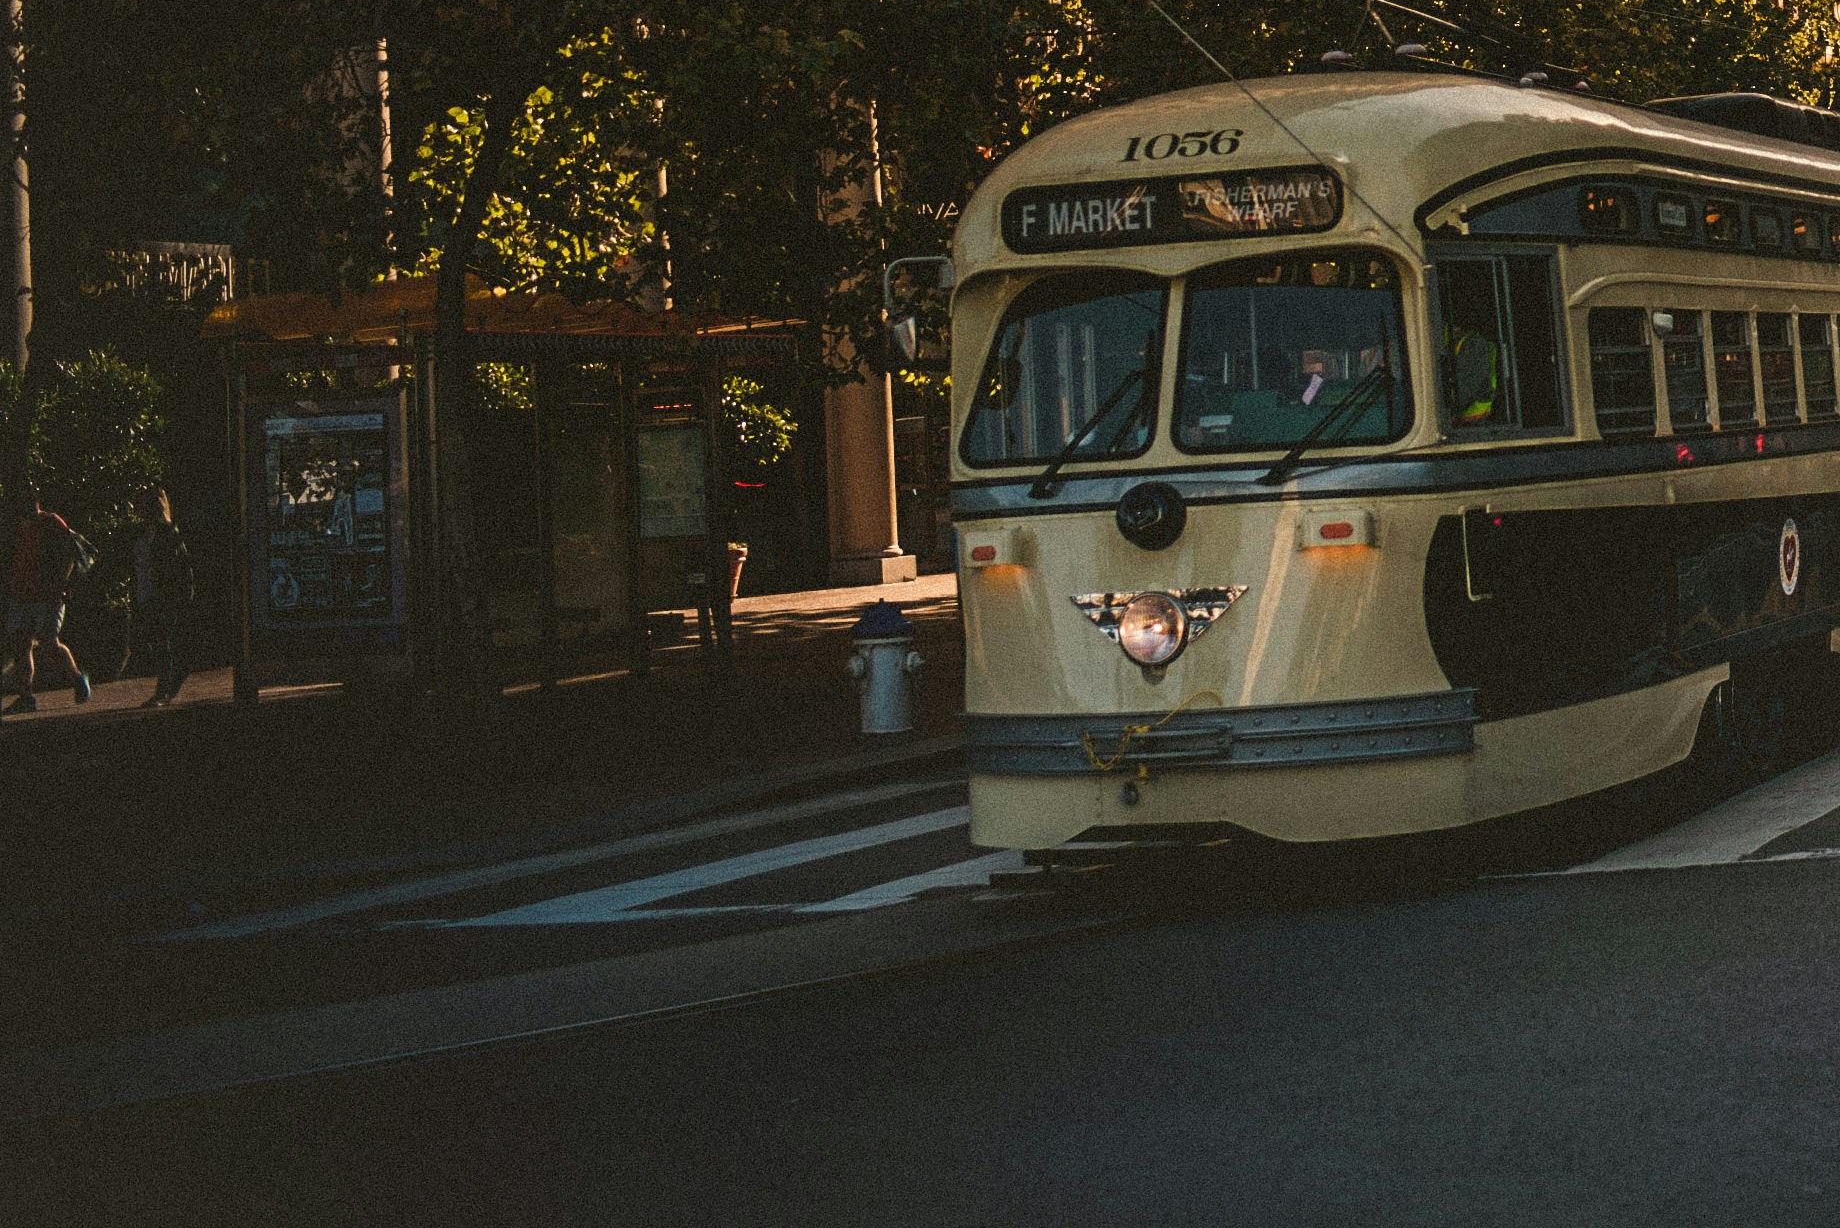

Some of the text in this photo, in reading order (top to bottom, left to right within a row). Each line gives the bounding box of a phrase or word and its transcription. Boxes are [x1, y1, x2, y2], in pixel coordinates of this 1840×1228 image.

[1118, 129, 1244, 163] 1056
[1194, 180, 1331, 208] FISHERMAN'S
[1021, 194, 1157, 237] F MARKET
[1227, 201, 1299, 223] WHARF
